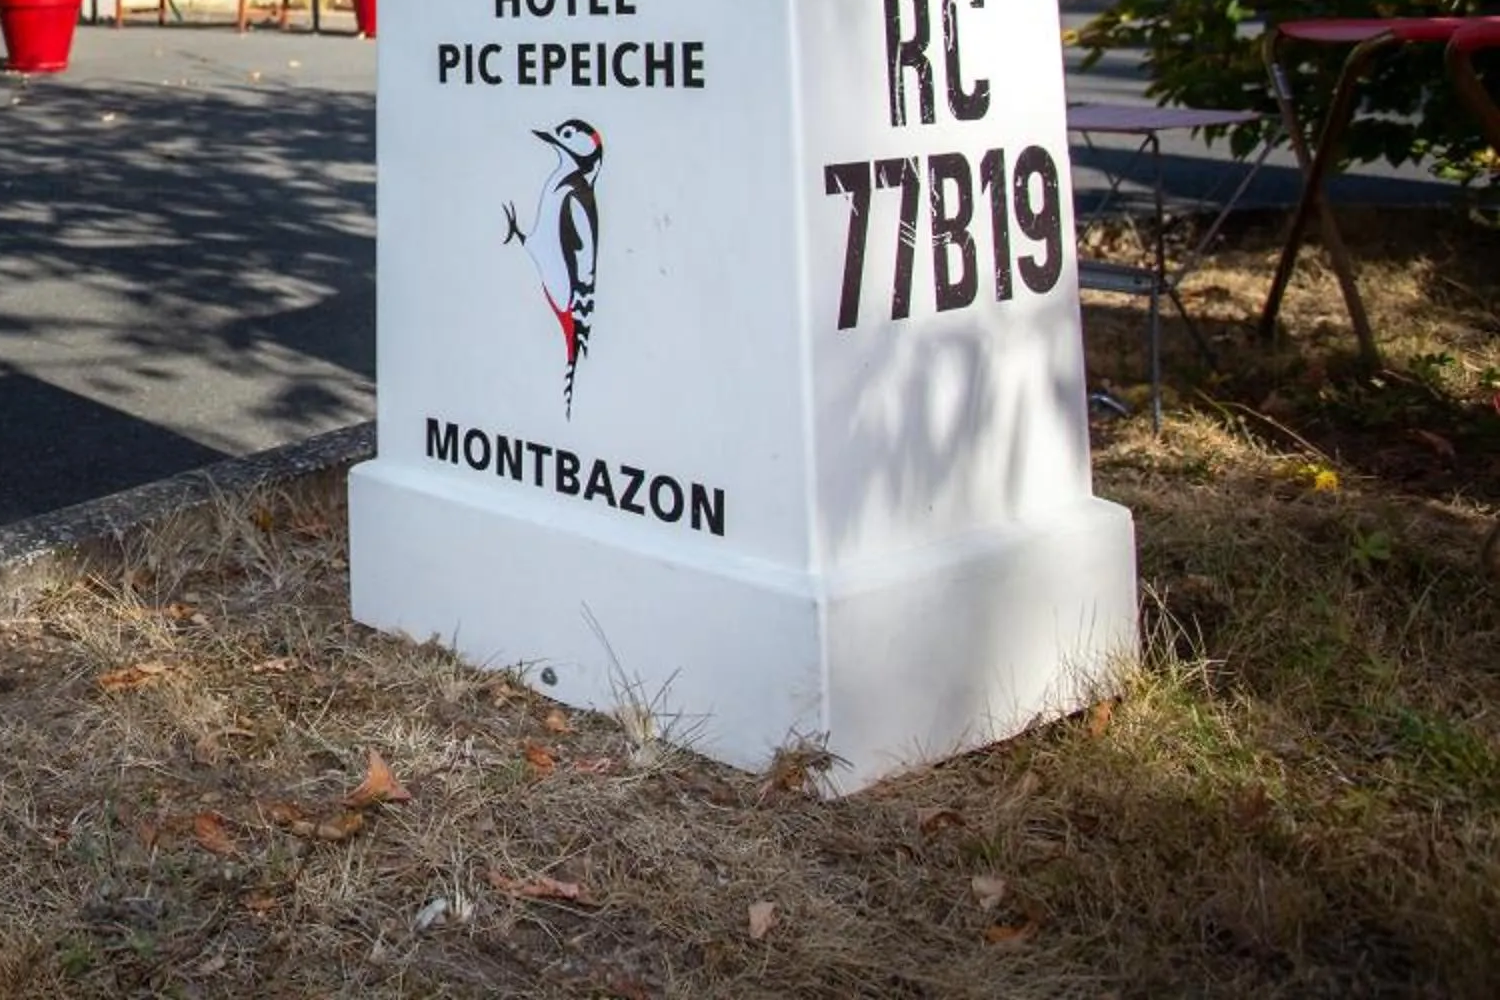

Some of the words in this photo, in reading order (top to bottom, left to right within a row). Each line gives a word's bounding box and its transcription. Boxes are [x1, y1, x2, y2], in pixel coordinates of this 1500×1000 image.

[438, 42, 503, 86] PIC
[517, 41, 706, 89] EPEICHE
[823, 145, 1064, 331] 77B19
[425, 417, 726, 538] MONTBAZON
